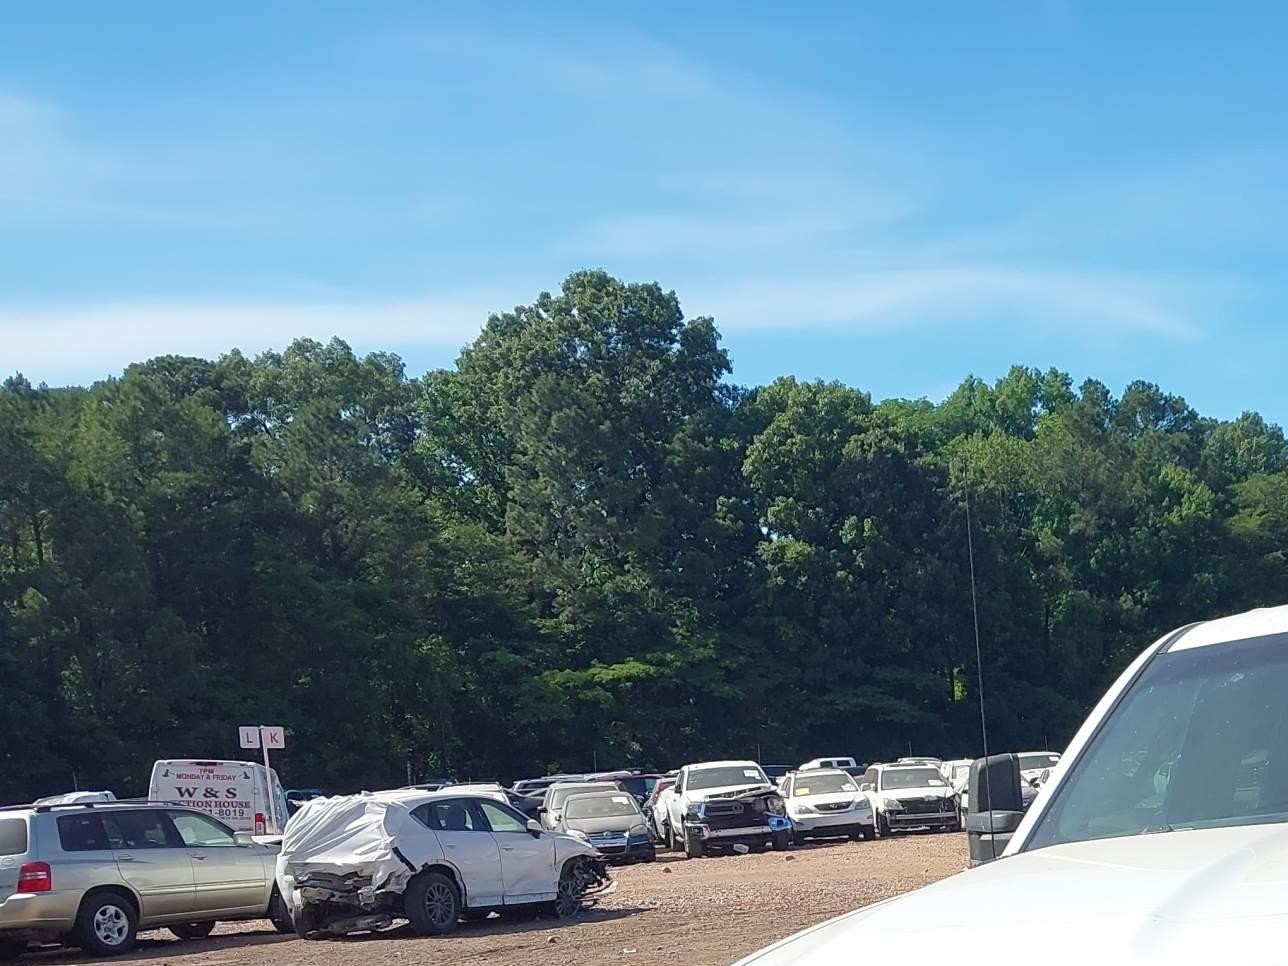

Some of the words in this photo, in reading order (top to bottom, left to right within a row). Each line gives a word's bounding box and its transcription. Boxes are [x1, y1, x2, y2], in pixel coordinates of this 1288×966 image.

[246, 732, 254, 744] L
[270, 732, 279, 744] K
[174, 786, 199, 798] W
[203, 787, 220, 799] &
[225, 787, 237, 799] S
